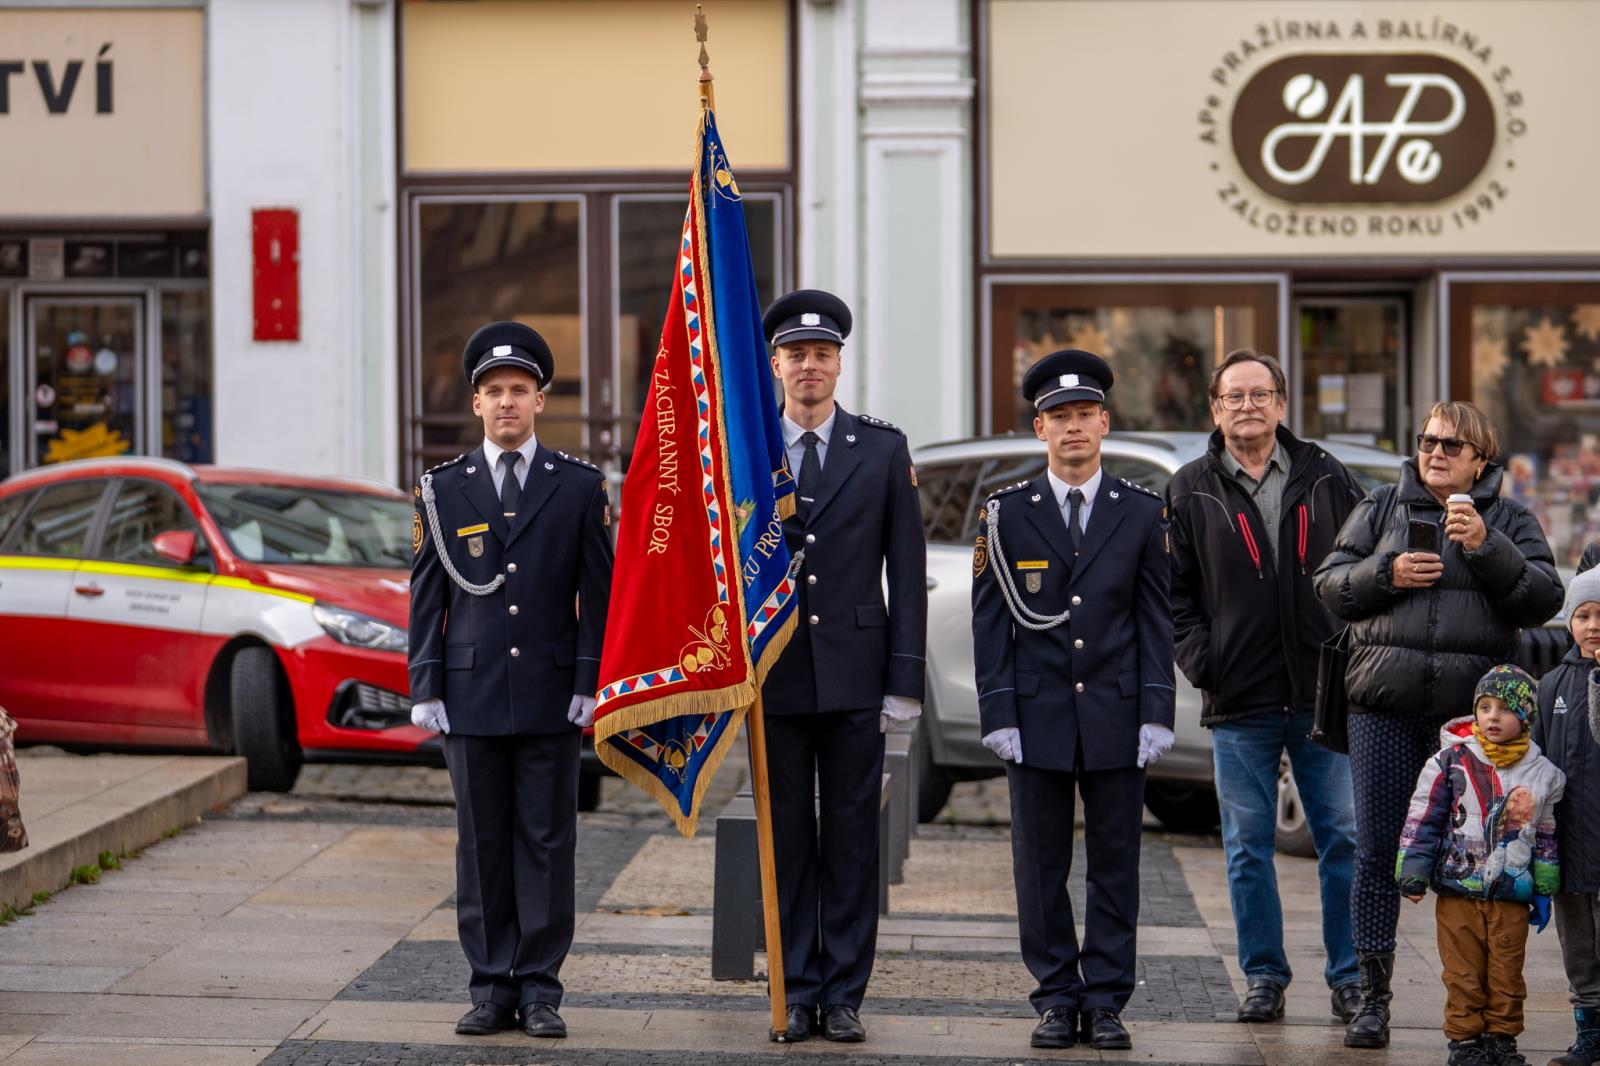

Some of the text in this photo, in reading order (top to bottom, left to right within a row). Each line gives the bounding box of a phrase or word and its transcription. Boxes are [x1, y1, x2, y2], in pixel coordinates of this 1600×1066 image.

[1210, 18, 1342, 87] PRAŽÍRNA
[1350, 20, 1368, 39] A
[1377, 15, 1492, 66] BALÍRNA
[1217, 179, 1508, 238] ZALOŽENO ROKU 1992
[653, 368, 682, 496] ZÁCHRANNÝ
[647, 503, 674, 555] SBOR
